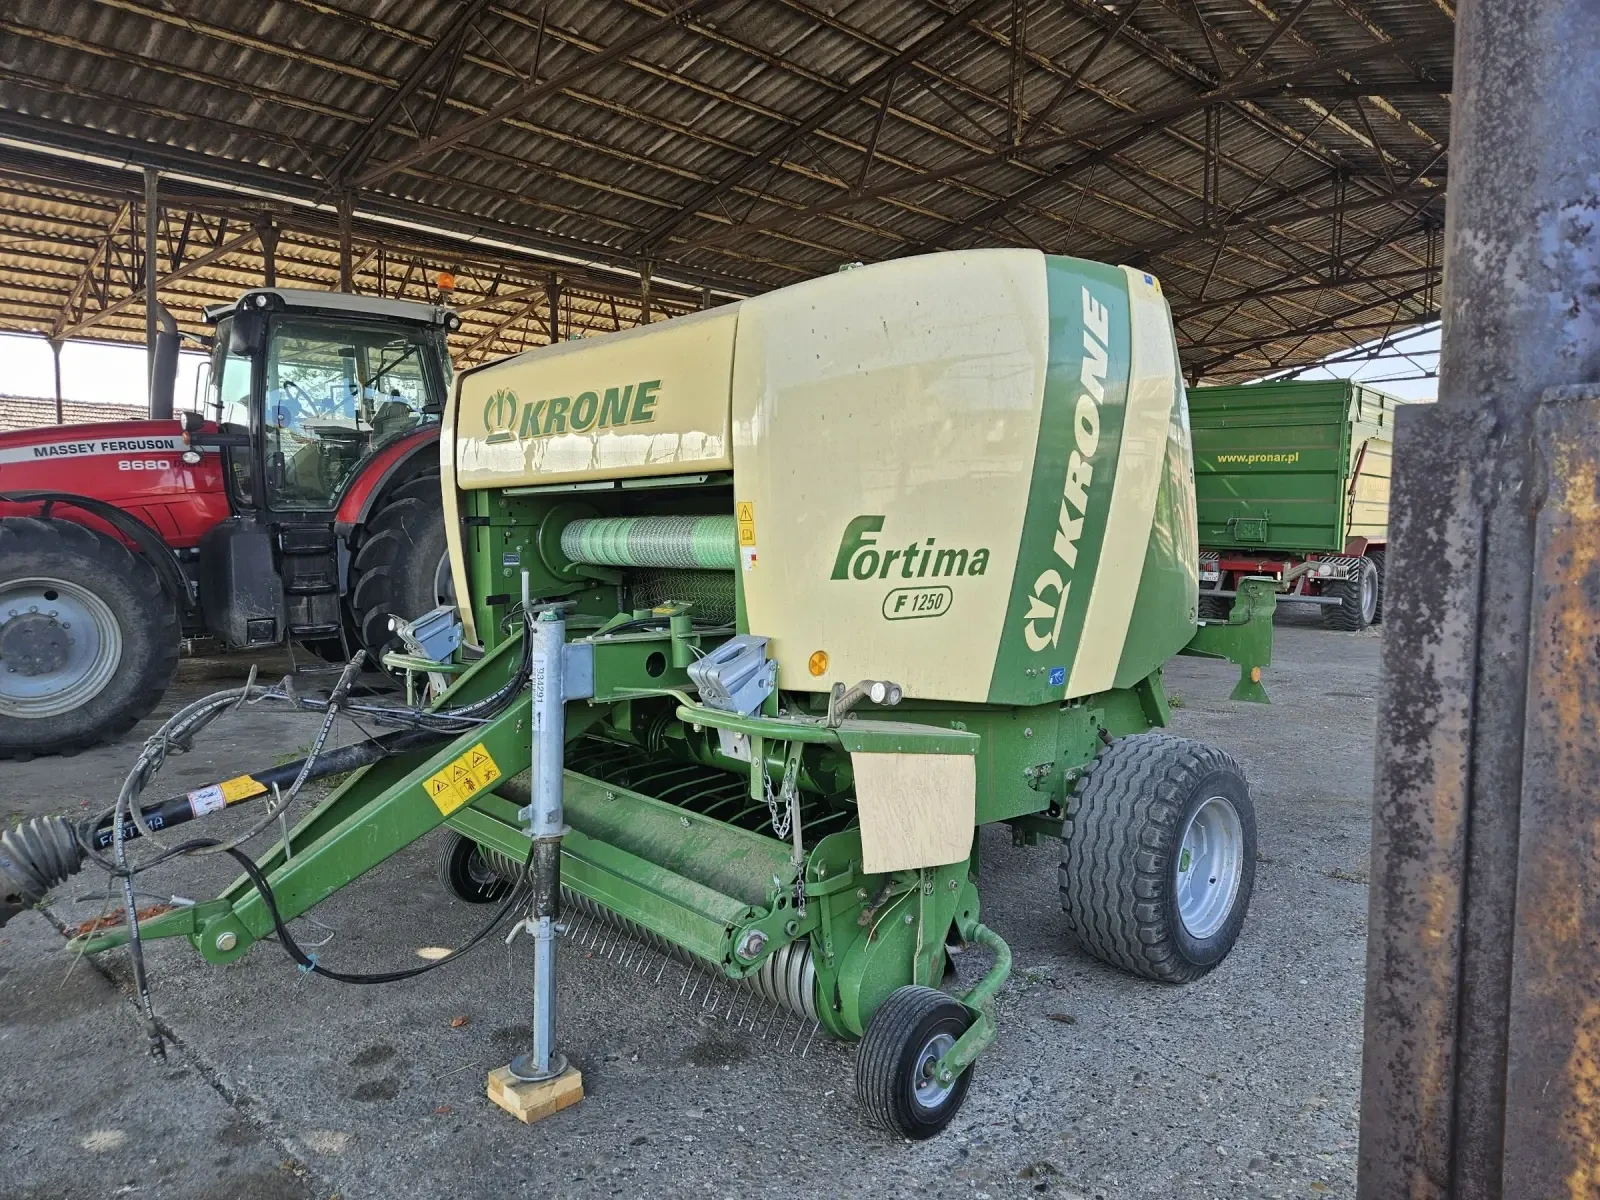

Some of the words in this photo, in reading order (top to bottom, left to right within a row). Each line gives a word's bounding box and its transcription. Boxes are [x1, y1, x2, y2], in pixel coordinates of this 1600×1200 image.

[519, 379, 662, 439] KRONE
[1053, 285, 1109, 569] KRONE
[34, 443, 96, 457] MASSEY
[101, 439, 174, 452] FERGUSON
[118, 460, 170, 471] 8680
[1217, 452, 1299, 465] www.pronar.pl
[830, 514, 990, 580] Fortima
[894, 595, 908, 612] F
[912, 592, 943, 612] 1250
